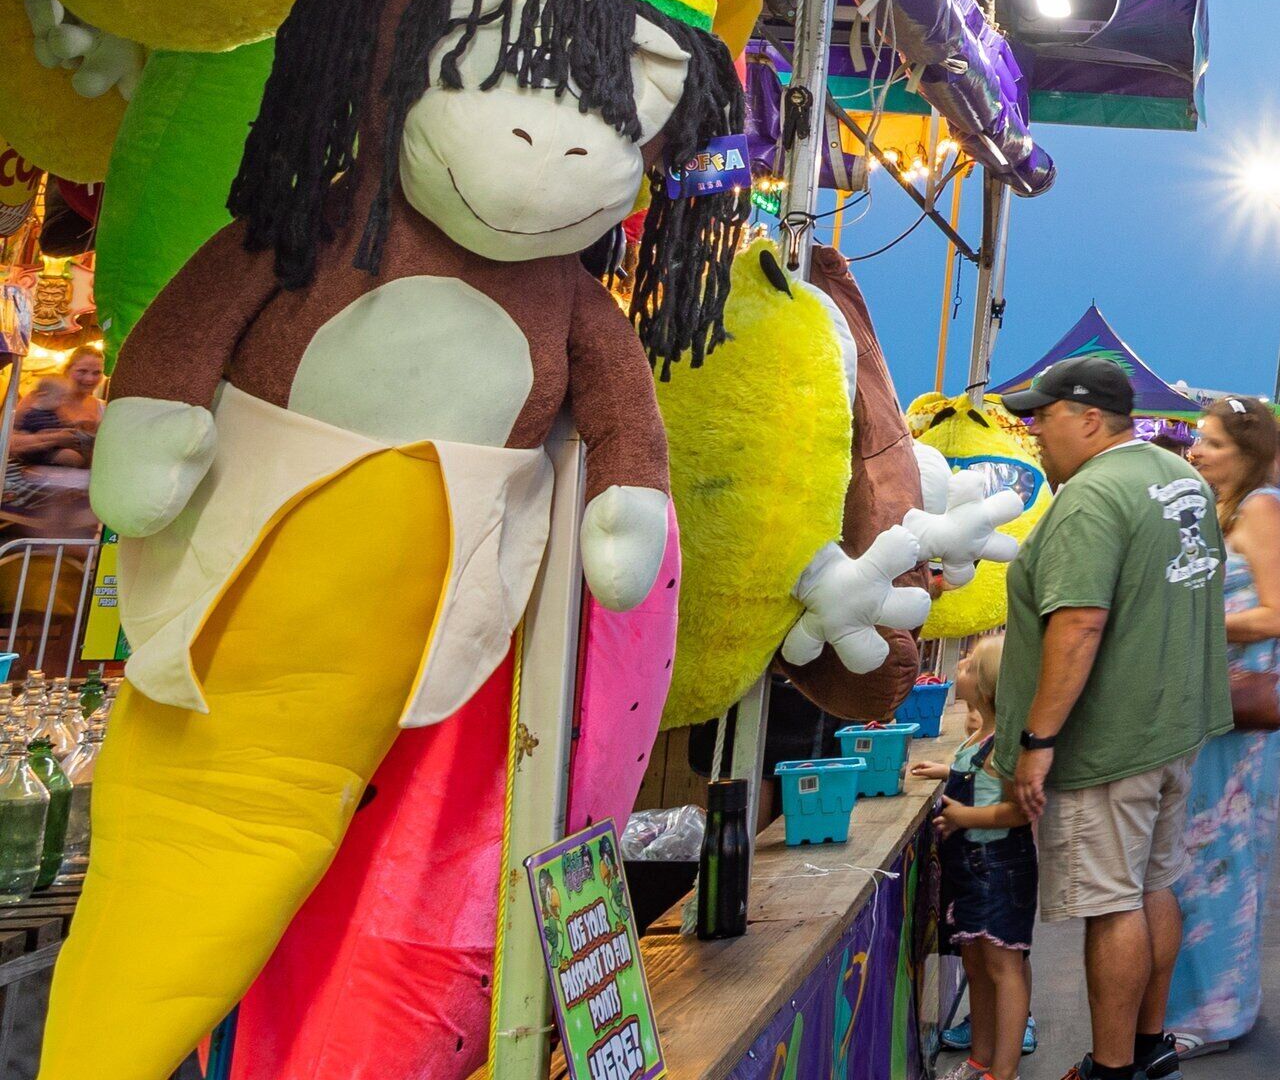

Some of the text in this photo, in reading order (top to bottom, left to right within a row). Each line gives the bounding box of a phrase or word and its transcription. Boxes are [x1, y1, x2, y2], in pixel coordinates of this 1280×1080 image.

[697, 180, 723, 191] USA
[567, 900, 610, 953] USE YOUR
[560, 930, 633, 1005] PASSPORT TO FUN
[589, 980, 621, 1031] POINTS
[590, 1020, 644, 1080] HERE!
